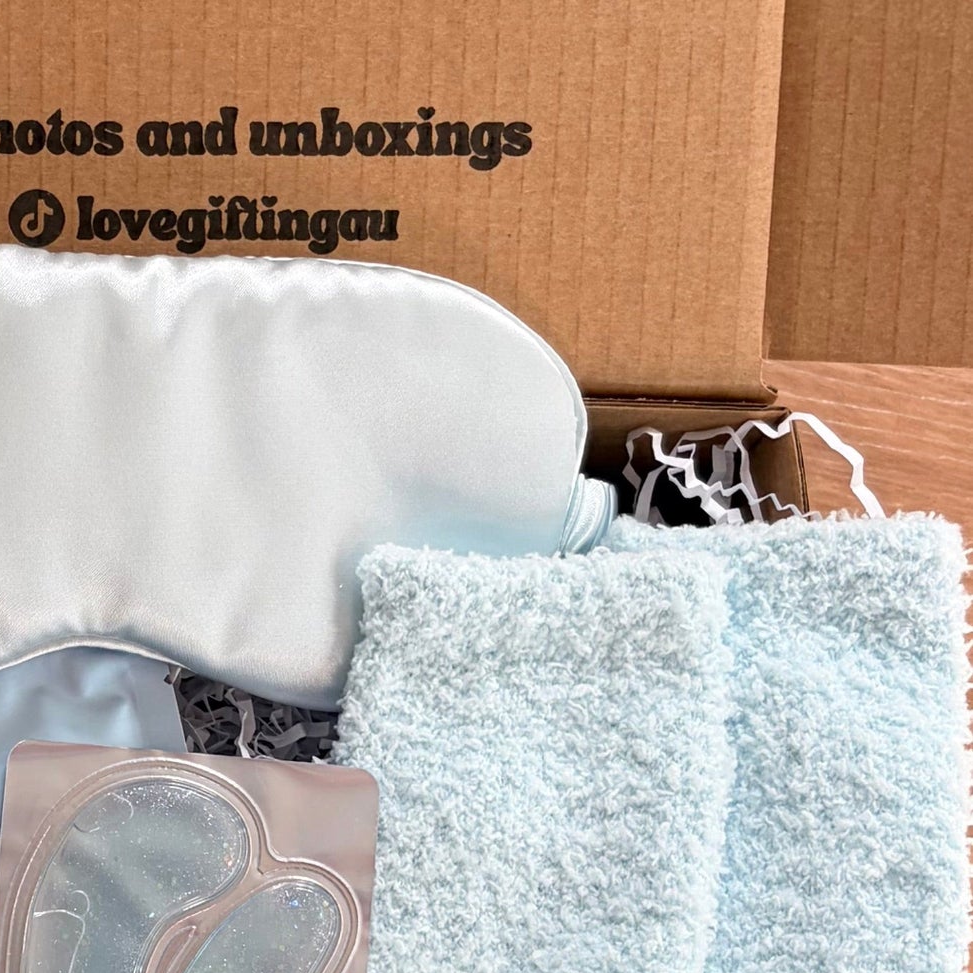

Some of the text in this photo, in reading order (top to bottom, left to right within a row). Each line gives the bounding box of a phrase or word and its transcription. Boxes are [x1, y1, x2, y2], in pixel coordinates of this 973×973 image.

[137, 107, 239, 156] and
[249, 106, 533, 171] unboxings
[76, 195, 400, 254] lovegiftingau
